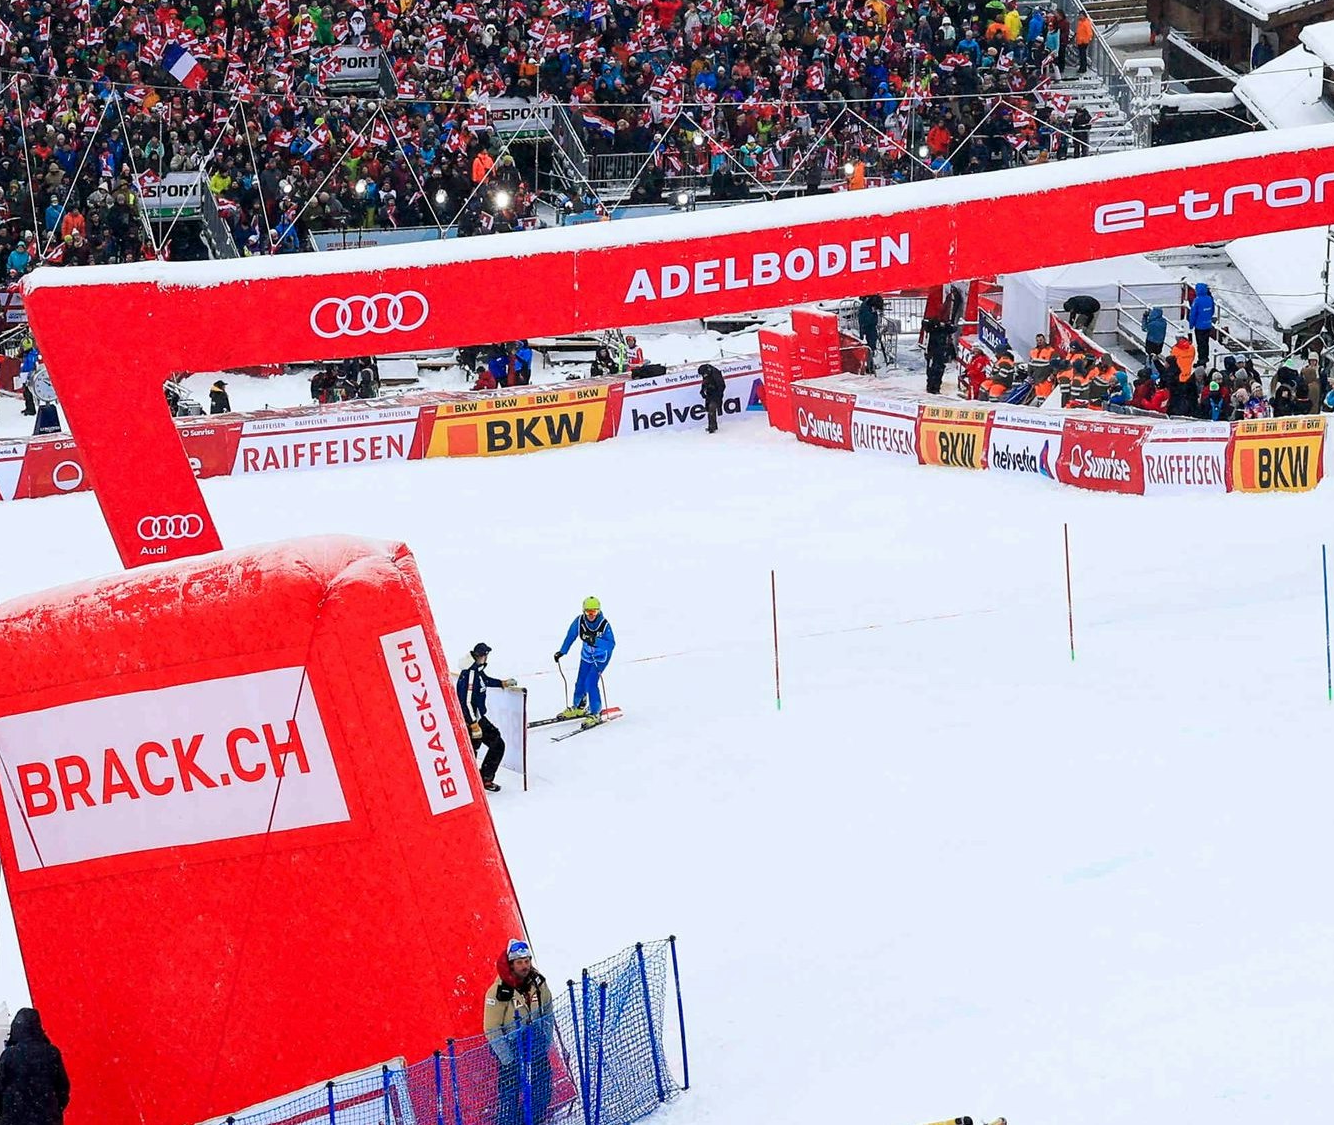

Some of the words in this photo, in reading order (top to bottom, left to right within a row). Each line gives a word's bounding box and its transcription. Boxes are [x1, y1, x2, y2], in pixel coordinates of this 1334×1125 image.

[340, 56, 377, 69] PORT
[502, 107, 551, 120] SPORT
[149, 185, 198, 198] SPORT
[624, 232, 911, 303] ADELBODEN
[454, 402, 478, 413] BKW
[494, 399, 518, 409] BKW
[536, 394, 559, 405] BKW
[577, 389, 599, 399] BKW
[190, 428, 215, 436] Sunrise
[252, 422, 286, 431] RAIFFEISEN
[295, 418, 328, 427] RAIFFEISEN
[336, 414, 370, 423] RAIFFEISEN
[378, 410, 412, 419] RAIFFEISEN
[486, 411, 584, 453] BKW
[808, 412, 845, 444] Sunrise
[242, 434, 404, 473] RAIFFEISEN
[853, 422, 916, 456] RAIFFEISEN
[938, 431, 977, 468] BKW
[992, 442, 1039, 473] helvetia
[1084, 449, 1131, 482] Sunrise
[1145, 455, 1224, 485] RAIFFEISEN
[1258, 446, 1309, 488] BKW
